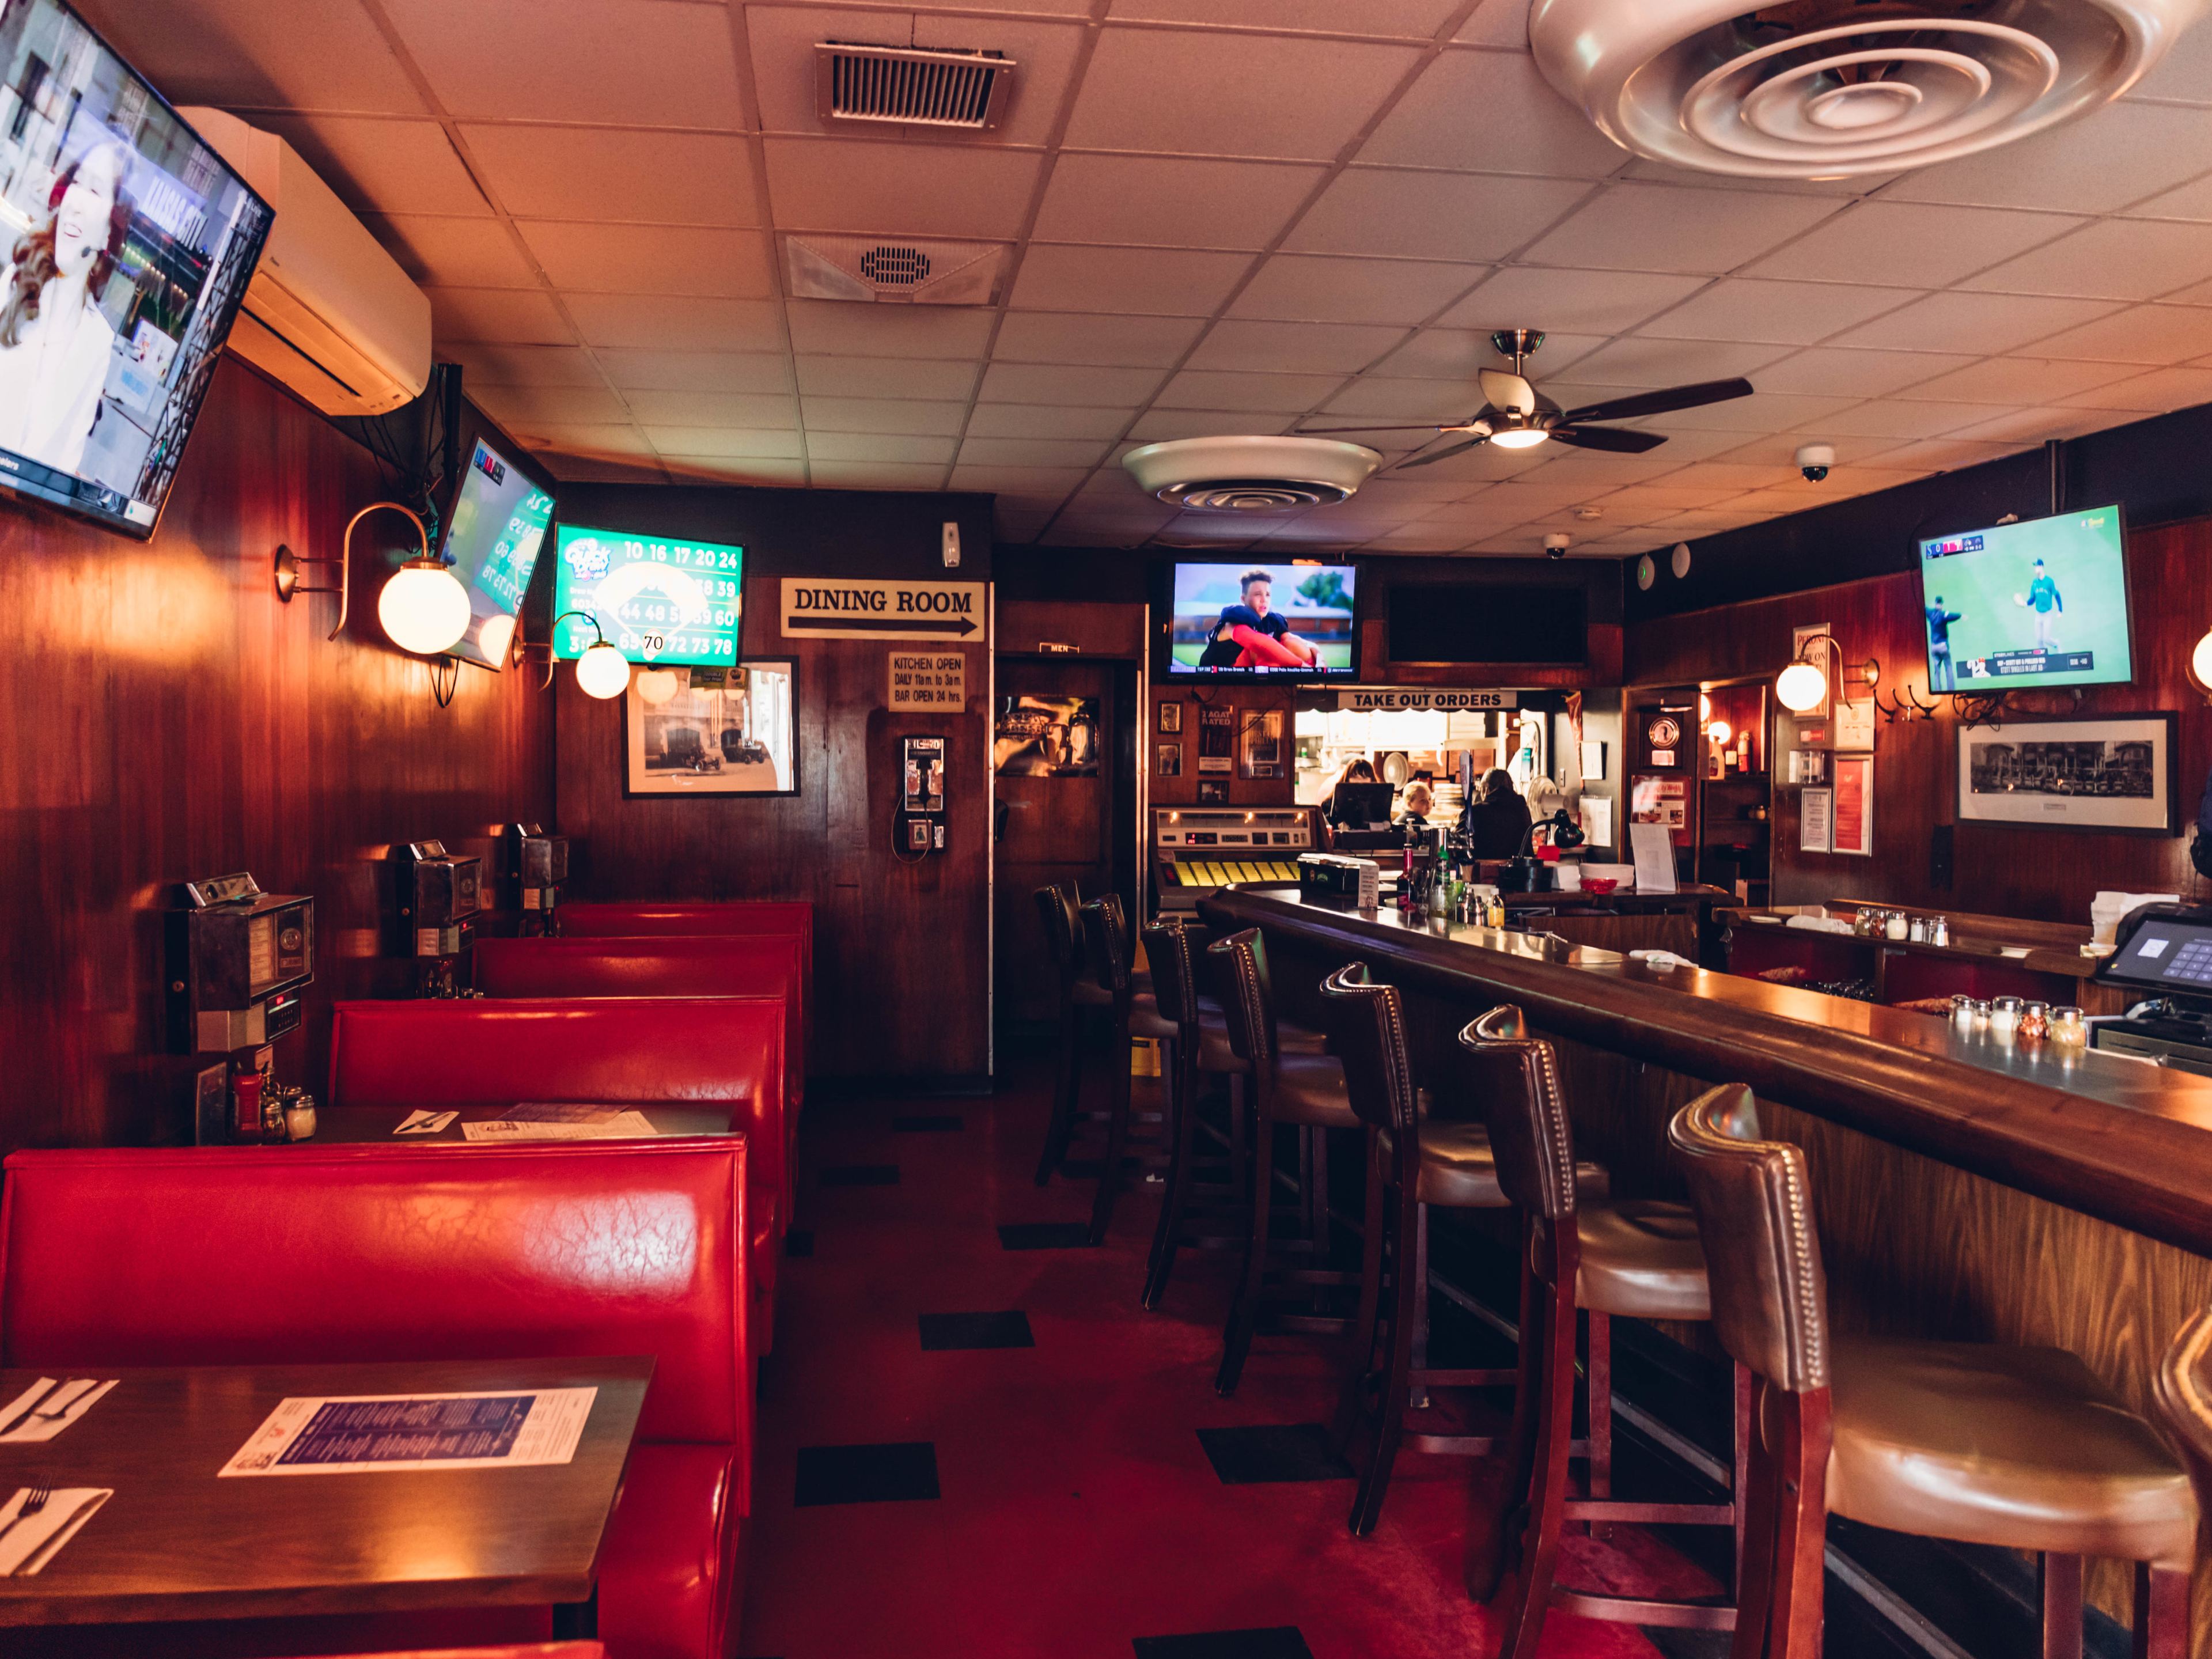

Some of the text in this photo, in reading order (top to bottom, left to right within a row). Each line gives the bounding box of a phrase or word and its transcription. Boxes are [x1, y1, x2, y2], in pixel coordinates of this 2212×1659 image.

[143, 176, 187, 236] KANSAS
[565, 545, 611, 564] Quick
[624, 541, 737, 569] 10 16 17 20 24
[717, 581, 736, 597] 39
[795, 589, 972, 613] DINING ROOM
[621, 603, 641, 619] 44
[645, 605, 665, 622] 48
[715, 609, 735, 627] 60
[644, 636, 663, 650] 70
[668, 637, 687, 653] 72
[692, 638, 710, 653] 73
[714, 639, 732, 655] 78
[1051, 645, 1069, 653] MEN
[894, 657, 961, 670] KITCHEN OPEN
[895, 673, 912, 685] DAILY
[936, 674, 942, 685] to
[895, 690, 961, 702] BAR OPEN 24 hrs.
[1354, 694, 1501, 706] TAKE OUT ORDERS
